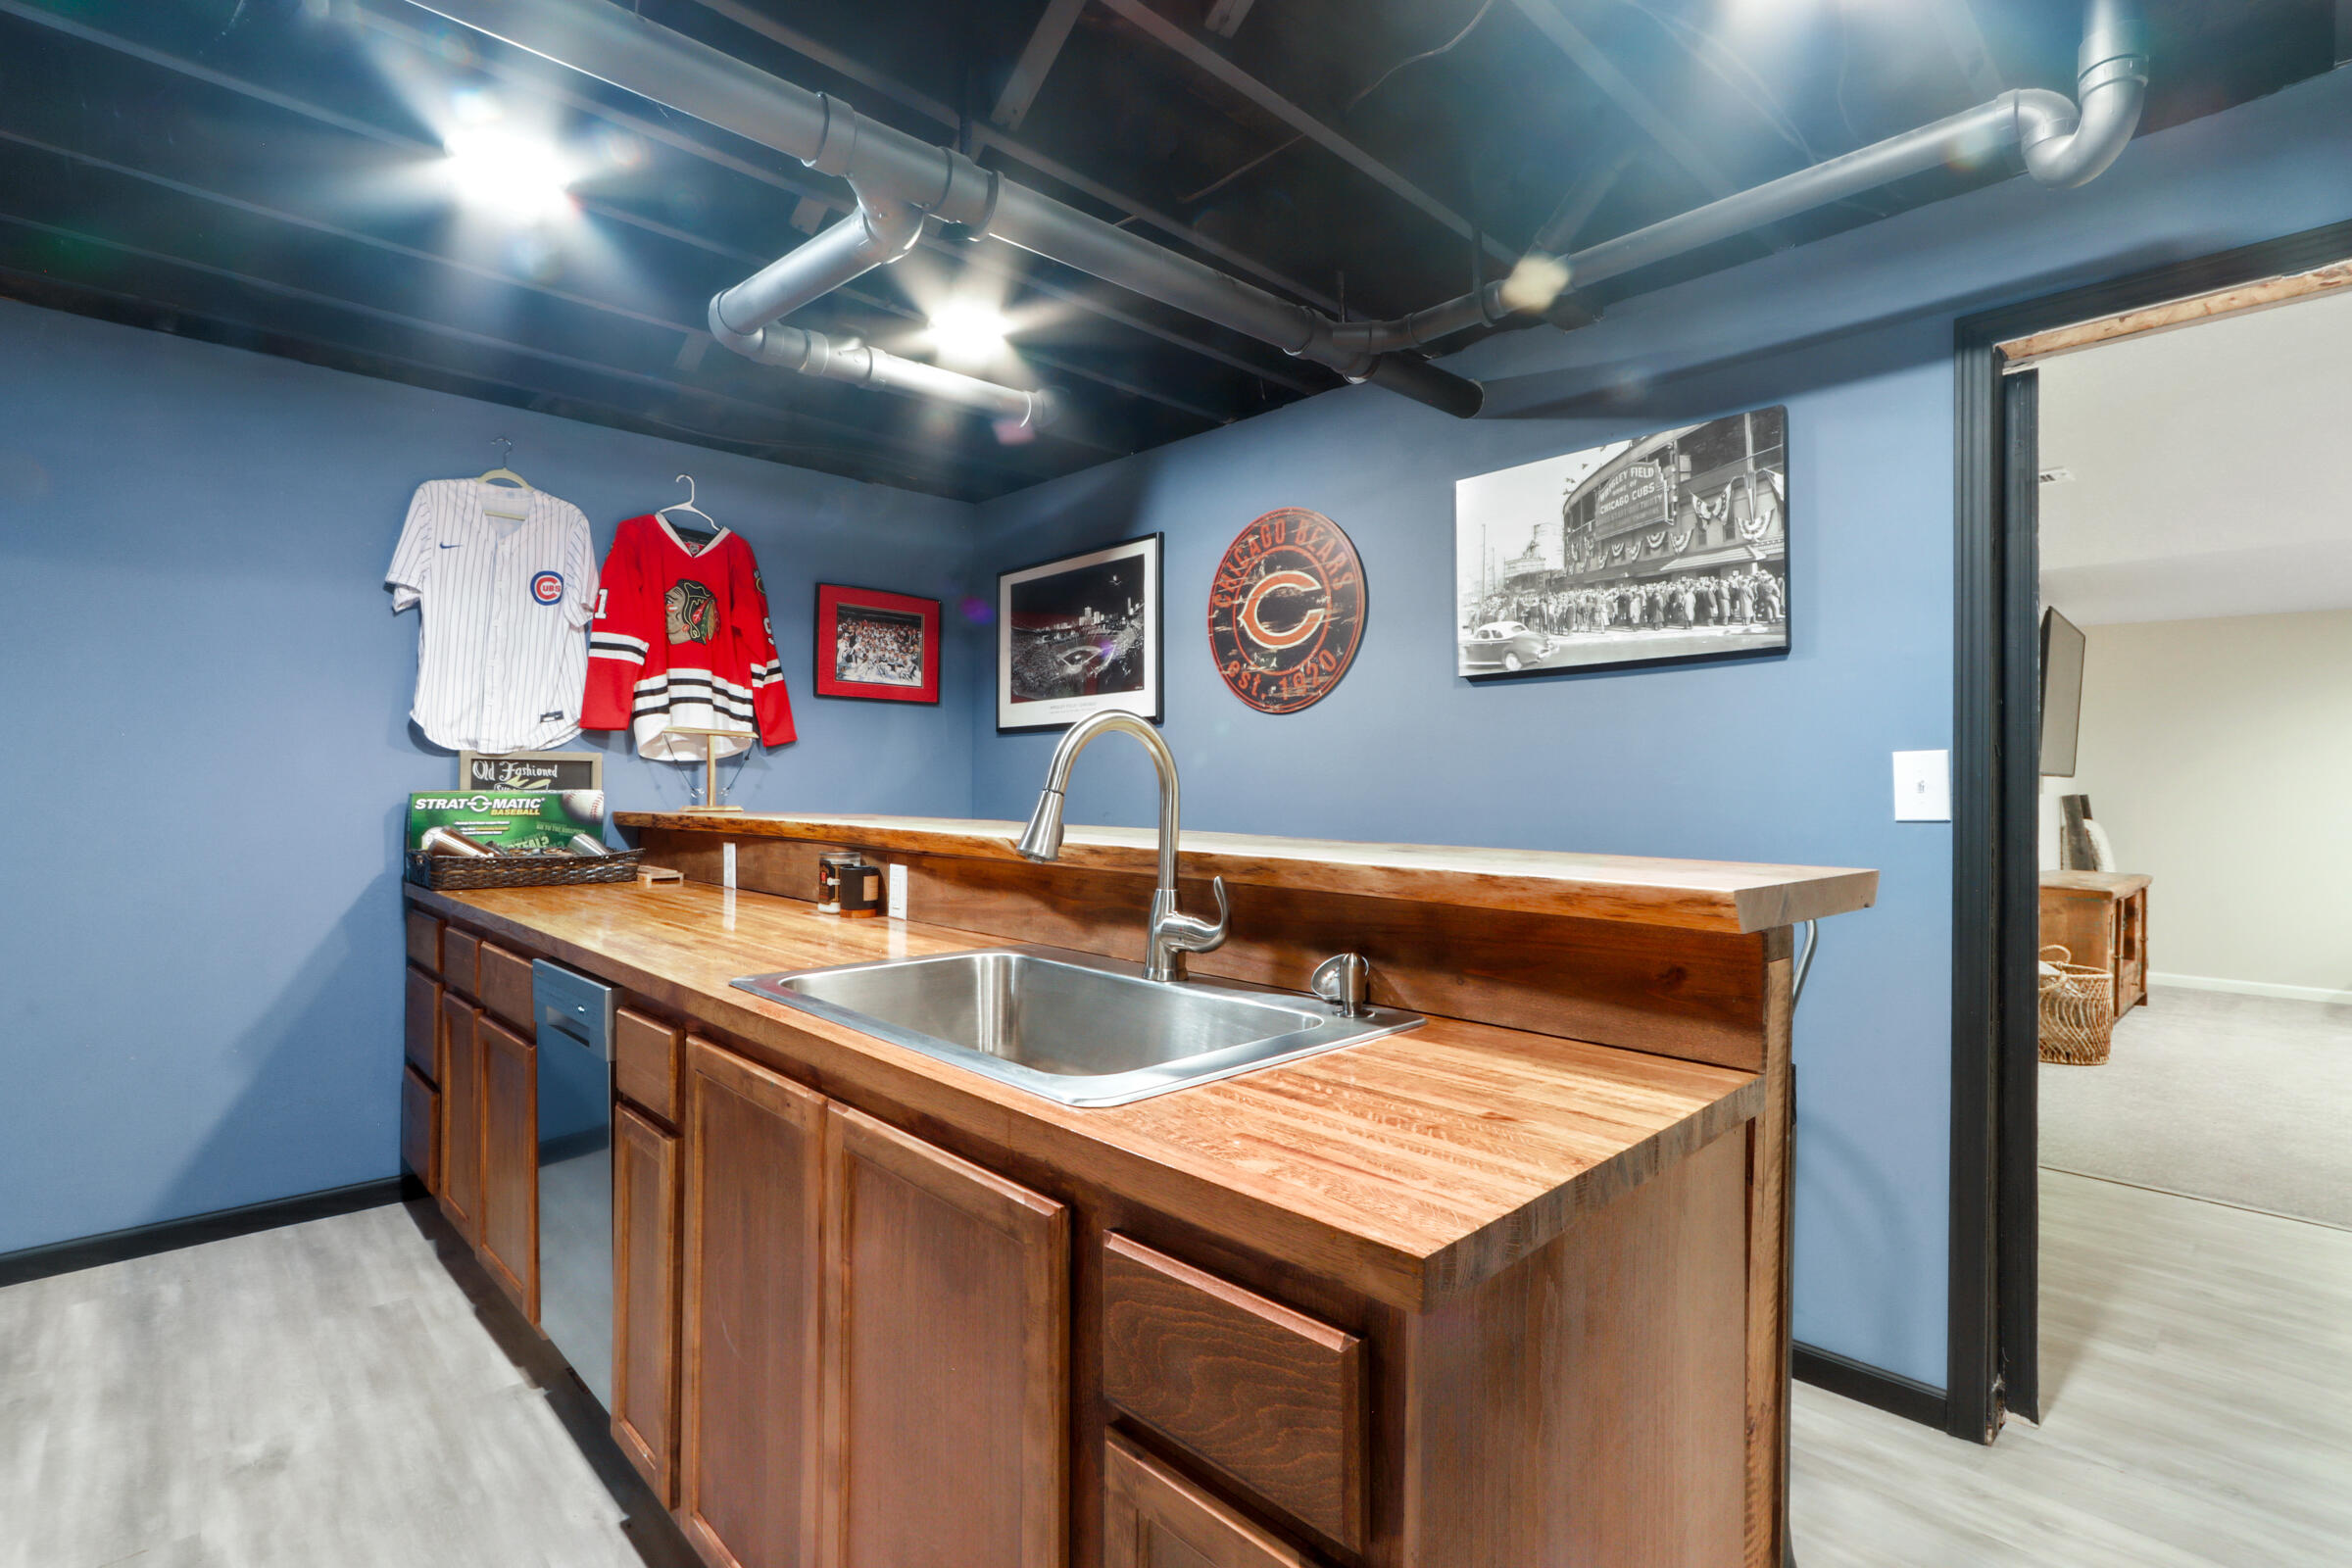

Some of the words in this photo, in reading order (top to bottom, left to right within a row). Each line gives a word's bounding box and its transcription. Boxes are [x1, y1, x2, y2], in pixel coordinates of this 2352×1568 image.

[1631, 466, 1654, 478] FIELD
[1600, 494, 1630, 514] CHICAGO
[1632, 482, 1655, 501] CUBS
[1214, 518, 1286, 609] CHICAGO
[1296, 518, 1354, 591] BEARS
[536, 576, 562, 600] CUBS
[1227, 661, 1267, 700] est.
[1279, 650, 1337, 700] 1920
[472, 760, 495, 781] Old
[499, 761, 558, 781] Fashioned
